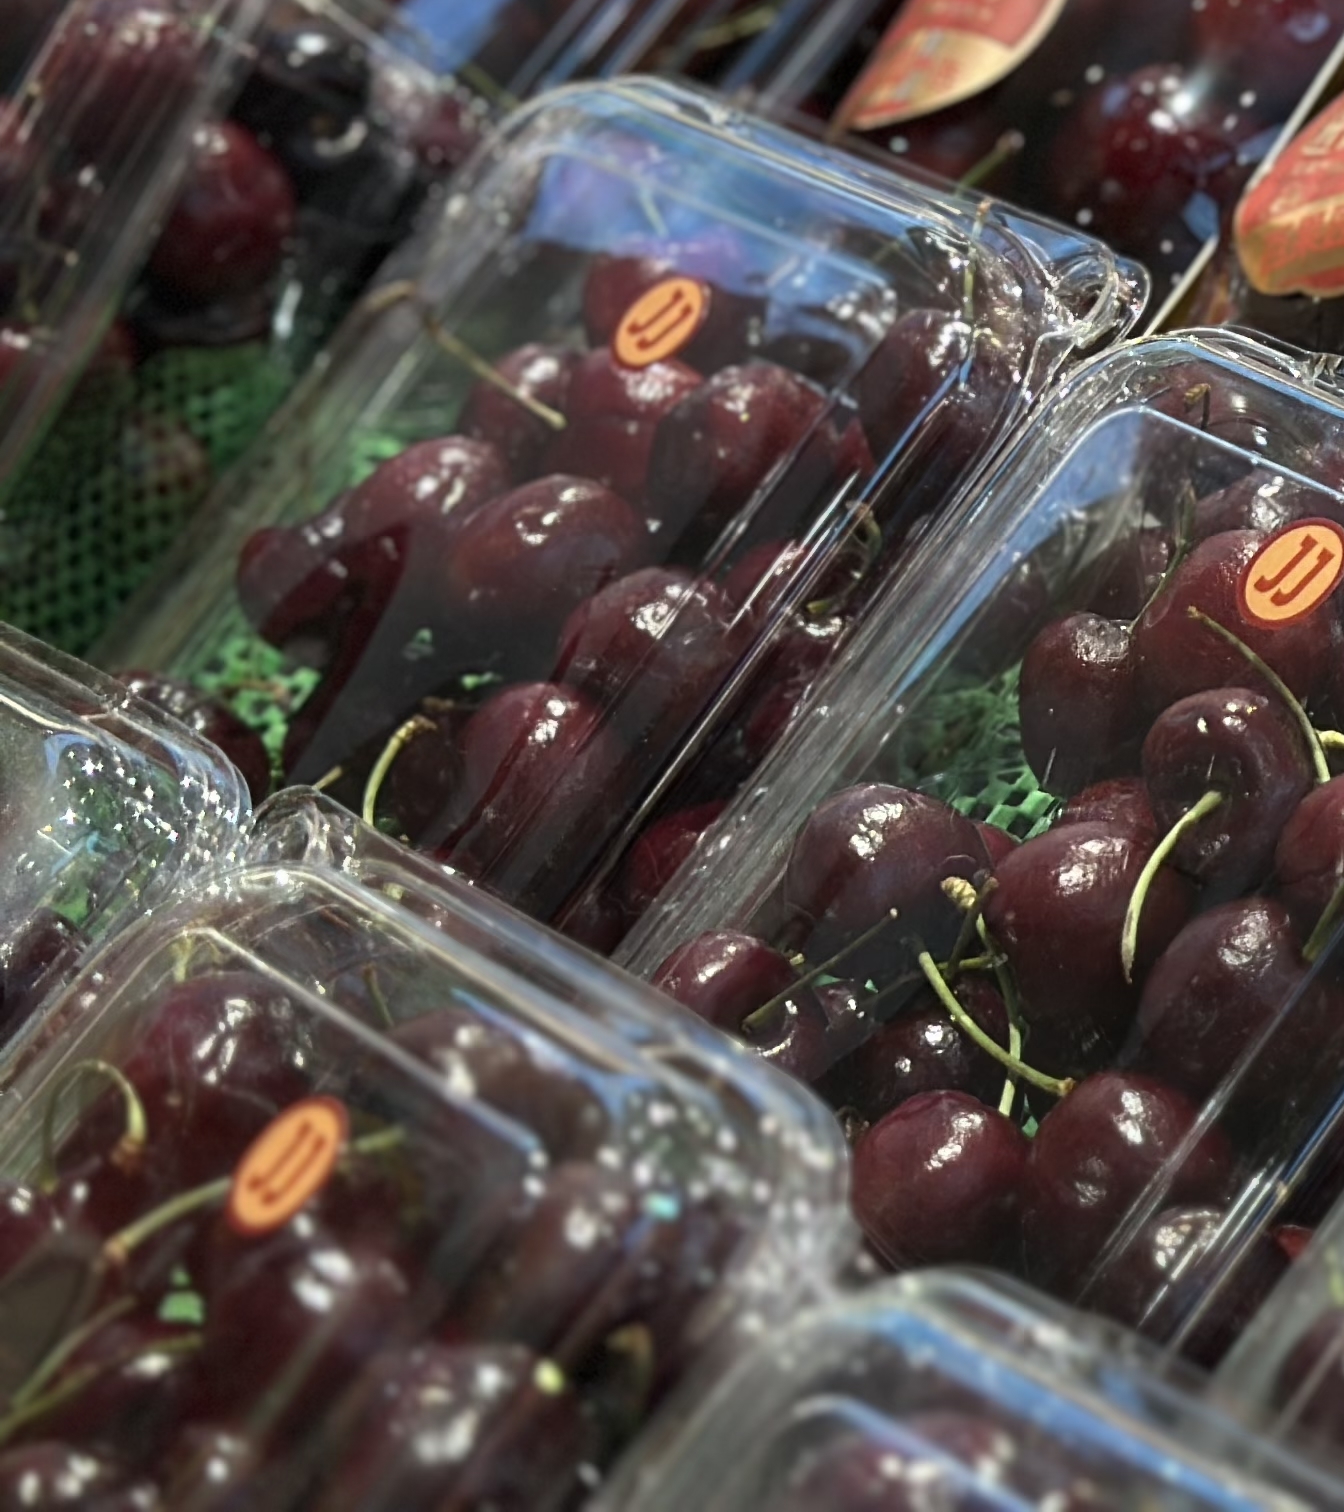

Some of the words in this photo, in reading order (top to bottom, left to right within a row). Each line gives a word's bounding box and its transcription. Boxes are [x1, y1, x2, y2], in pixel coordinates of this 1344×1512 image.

[626, 288, 693, 352] JJ
[1253, 533, 1336, 607] JJ
[248, 1121, 326, 1206] JJ
